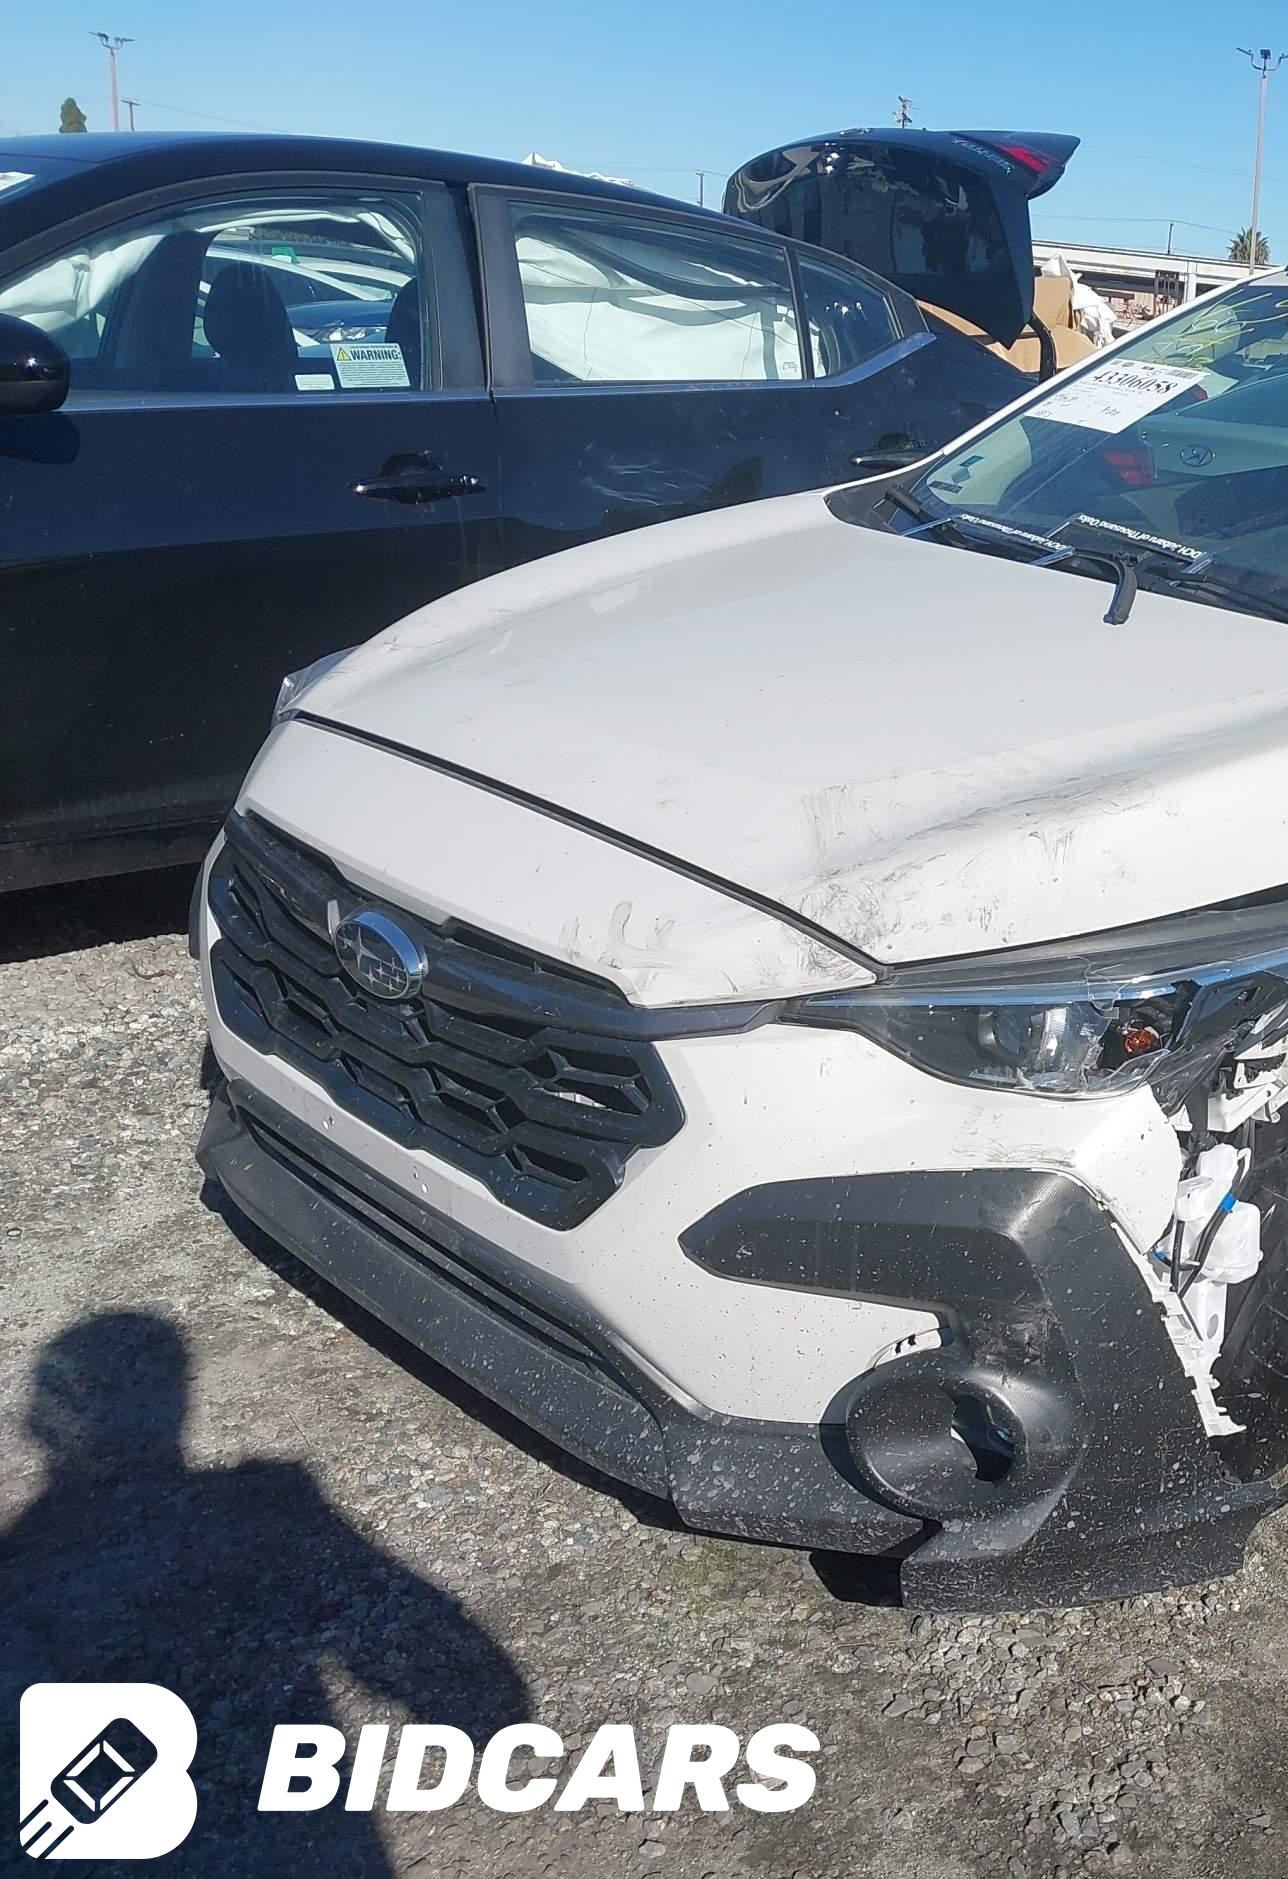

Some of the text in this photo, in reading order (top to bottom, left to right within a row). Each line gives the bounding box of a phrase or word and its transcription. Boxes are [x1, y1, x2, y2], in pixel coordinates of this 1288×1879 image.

[350, 349, 402, 361] WARNING:
[1093, 370, 1178, 395] 43306058
[1080, 513, 1101, 528] Oaks
[1099, 520, 1141, 541] Thousand
[1148, 534, 1181, 552] Subaru
[1179, 545, 1202, 559] DCH
